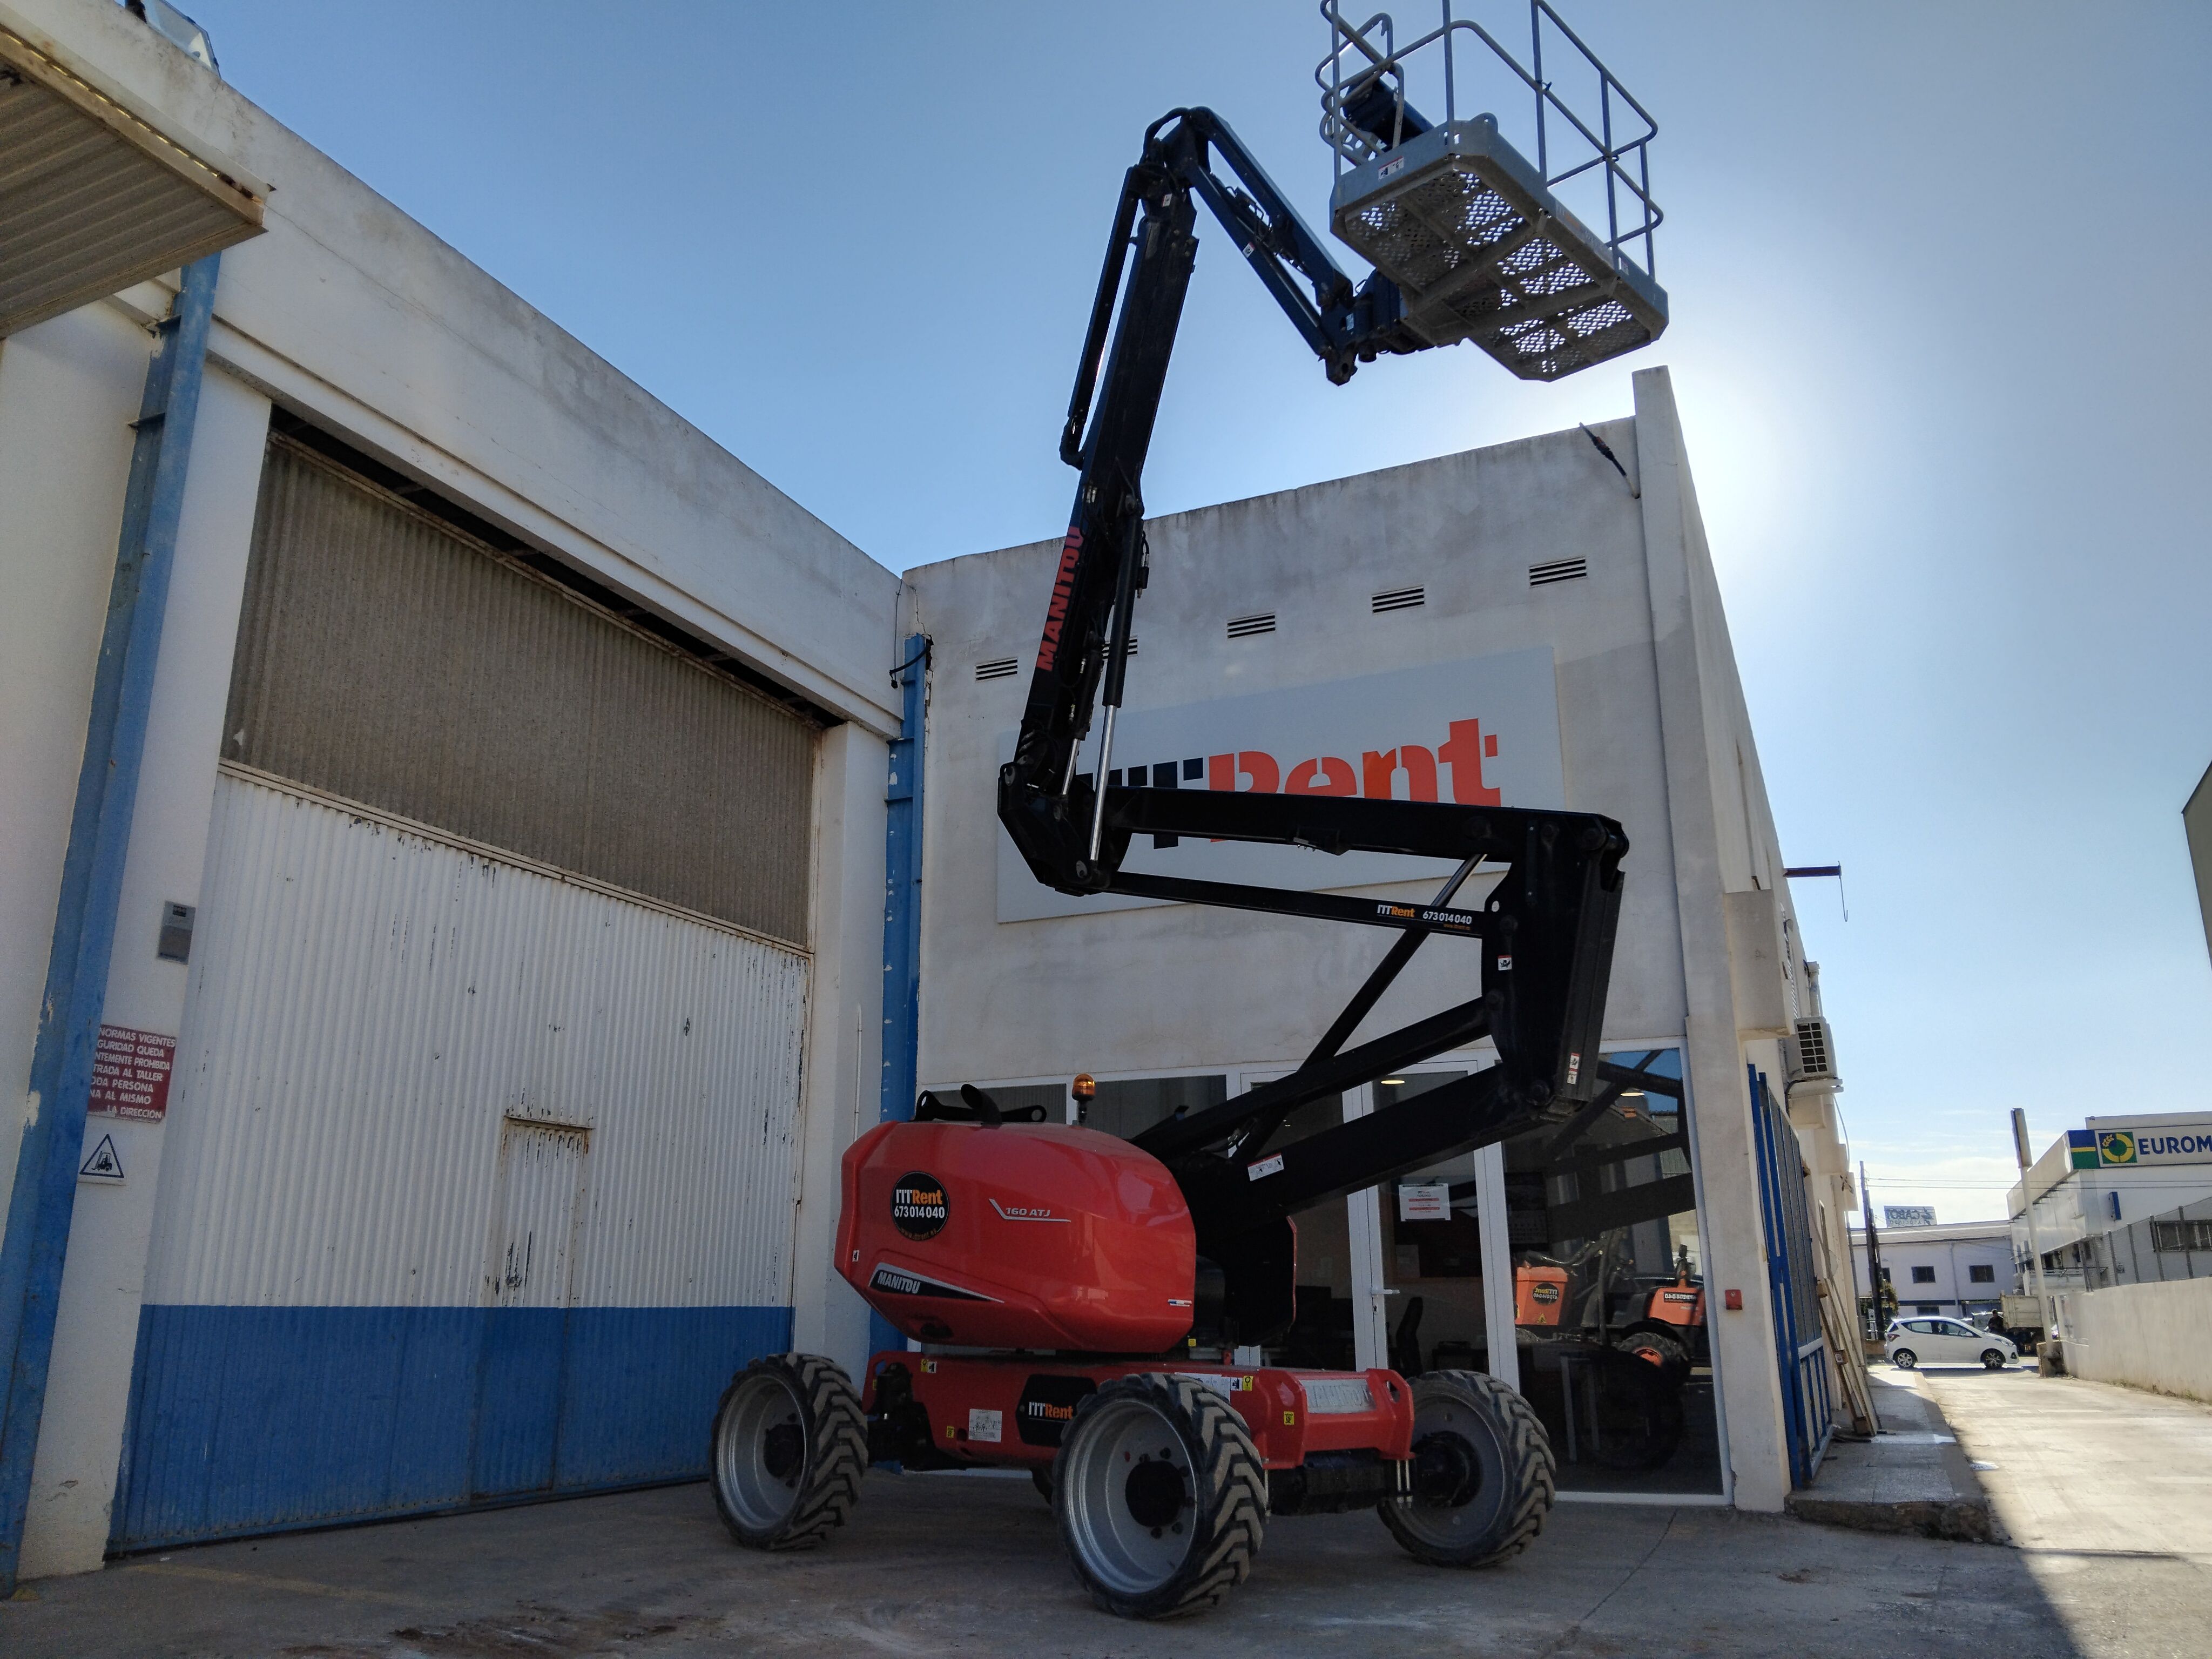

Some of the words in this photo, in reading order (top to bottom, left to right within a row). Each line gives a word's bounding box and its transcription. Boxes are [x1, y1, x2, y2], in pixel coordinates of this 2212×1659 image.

[1036, 526, 1084, 672] MANITOU
[100, 1027, 136, 1041] NORMAS
[139, 1034, 175, 1047] VIGENTES
[137, 1046, 164, 1057] QUEDA
[134, 1057, 170, 1070] PROHIBIDA
[123, 1068, 133, 1077] AL
[137, 1070, 163, 1081] TALLER
[112, 1080, 153, 1092] PERSONA
[105, 1091, 116, 1100] AL
[120, 1092, 151, 1104] MISMO
[107, 1105, 117, 1114] LA
[120, 1107, 161, 1118] DIRECCION
[2138, 1135, 2212, 1155] EUROM
[1006, 1208, 1027, 1216] 160
[878, 1271, 921, 1294] MANITOU
